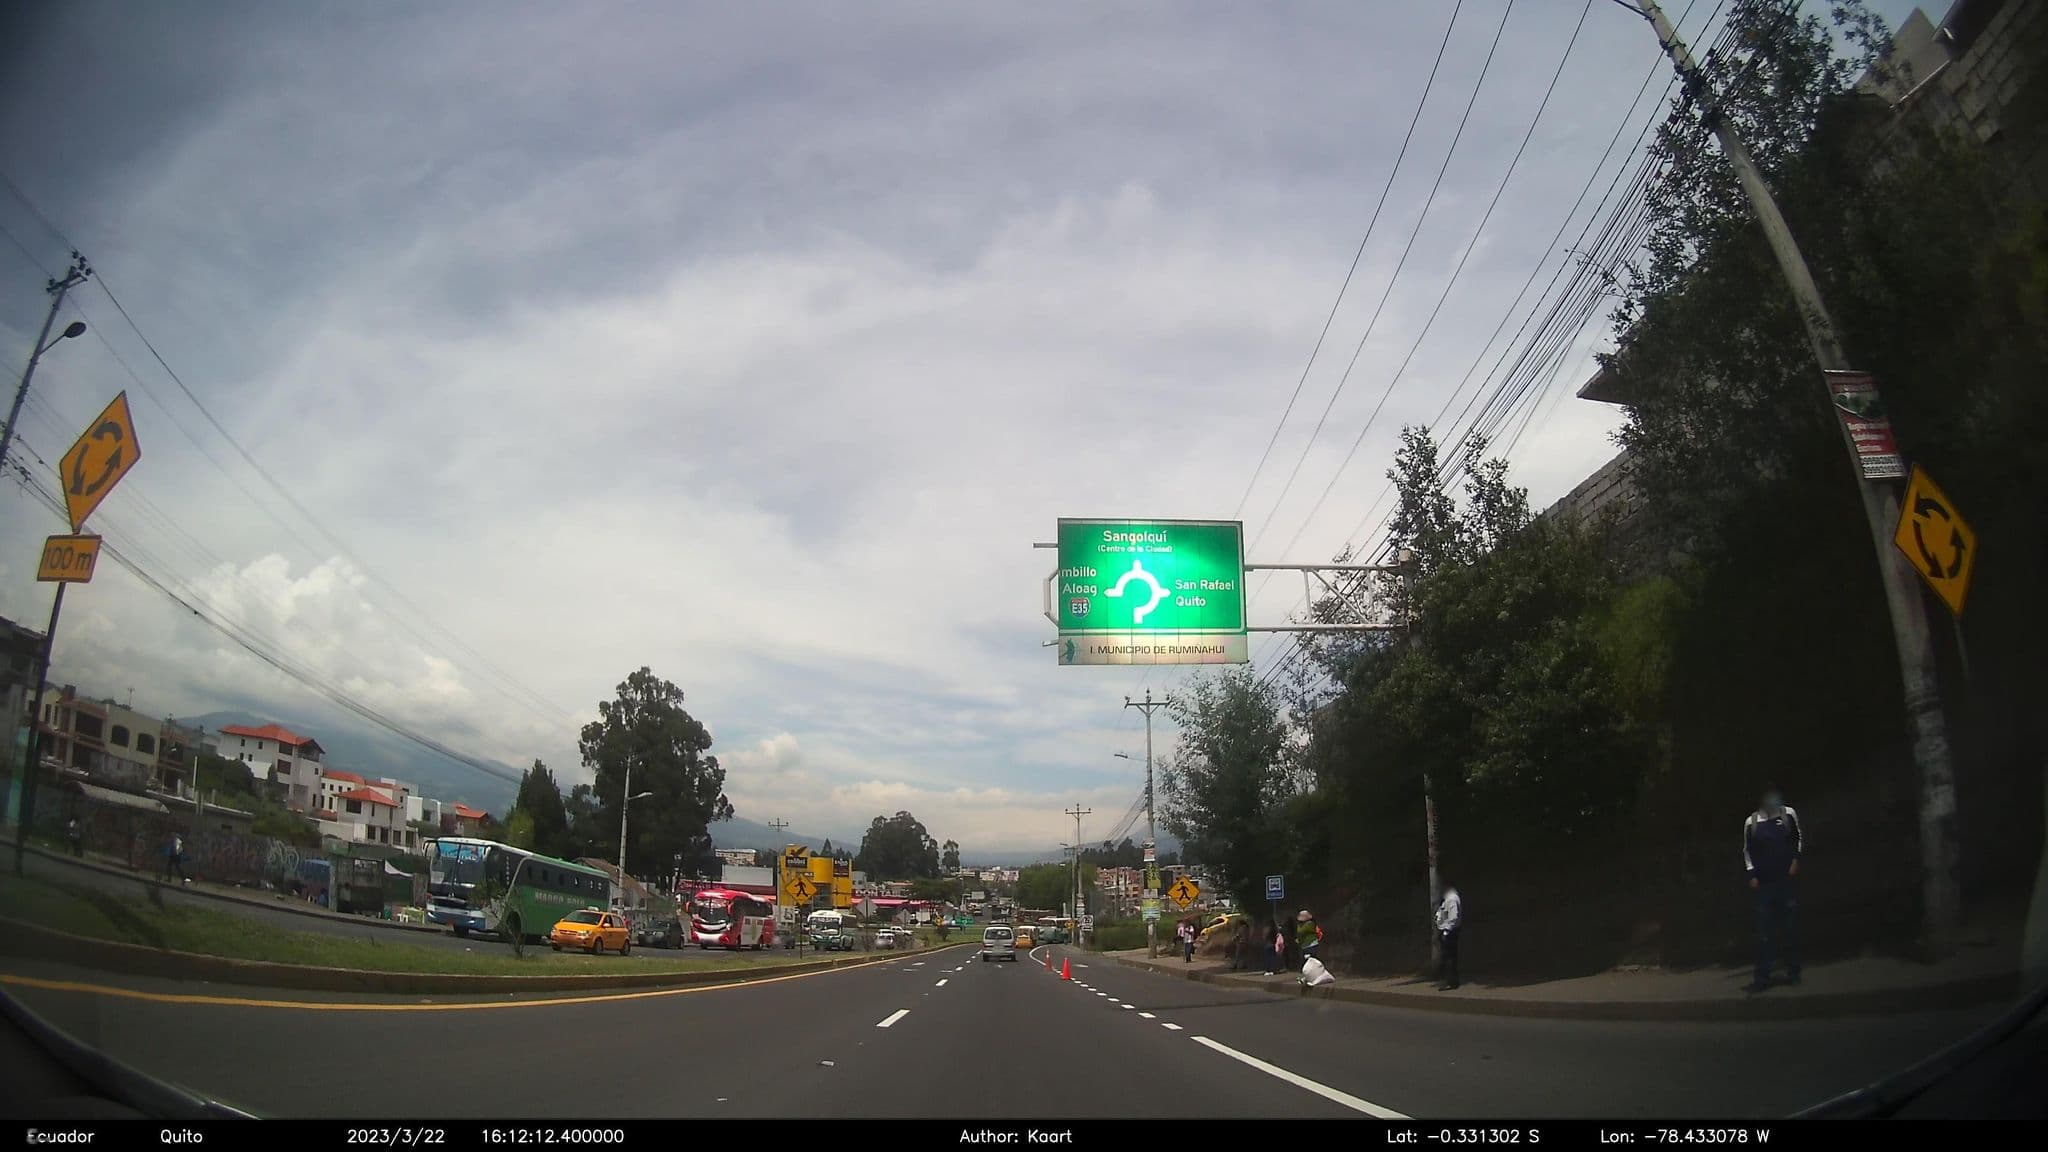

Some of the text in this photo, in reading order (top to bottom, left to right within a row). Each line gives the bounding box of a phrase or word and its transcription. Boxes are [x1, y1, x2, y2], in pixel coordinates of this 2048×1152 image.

[1103, 530, 1168, 545] Sangolquí
[75, 552, 92, 571] m
[1058, 566, 1097, 577] mbillo
[1062, 583, 1097, 597] Aloag
[1175, 579, 1235, 590] San Rafael
[1175, 596, 1206, 607] Quito
[1072, 603, 1088, 614] E35
[1097, 645, 1151, 654] MUNICIPIO
[1153, 645, 1166, 654] DE
